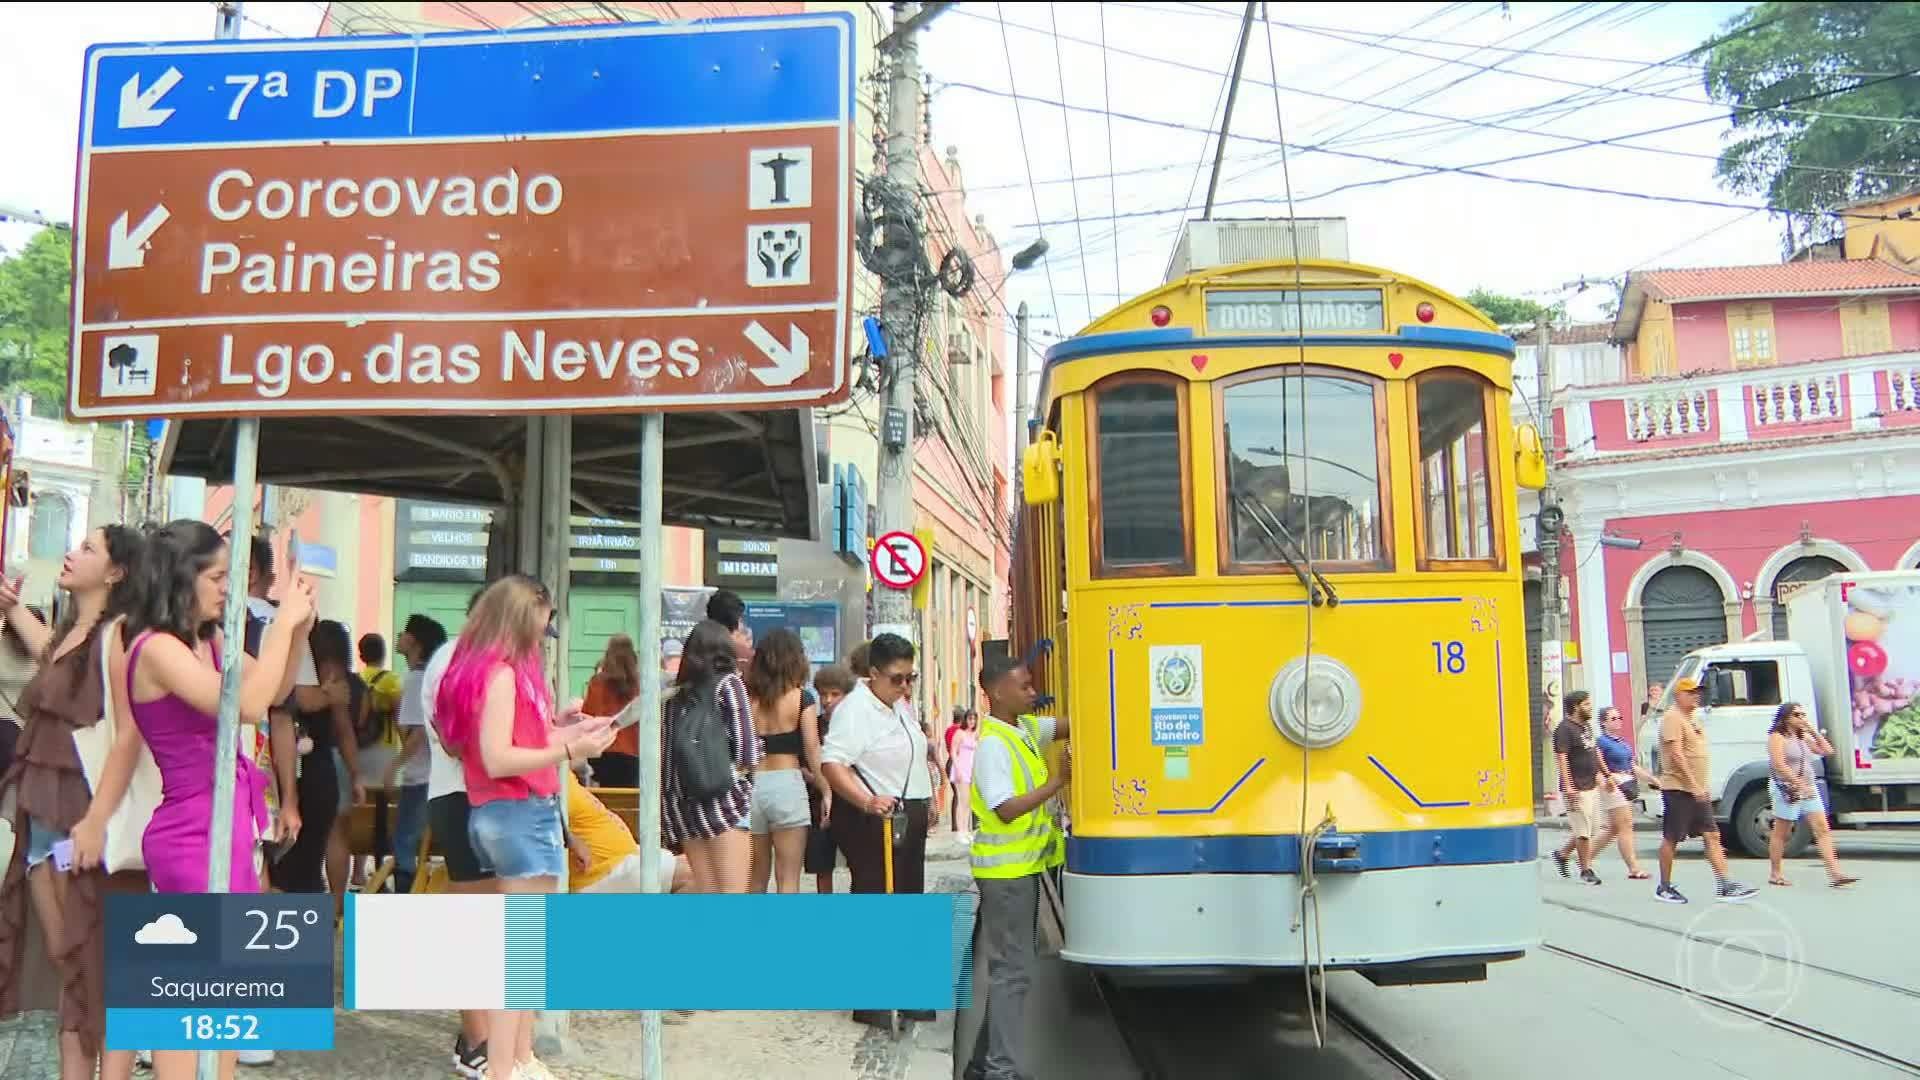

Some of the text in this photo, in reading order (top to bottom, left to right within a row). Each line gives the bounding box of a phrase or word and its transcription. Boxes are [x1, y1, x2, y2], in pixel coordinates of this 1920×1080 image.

[225, 69, 403, 120] 7ª DP
[207, 167, 563, 221] Corcovado
[200, 239, 501, 294] Paineiras
[1221, 302, 1272, 329] DOIS
[220, 329, 700, 398] Lgo. das Neves
[1431, 640, 1466, 674] 18
[1154, 719, 1191, 731] Rio de
[1154, 730, 1200, 741] Janeiro
